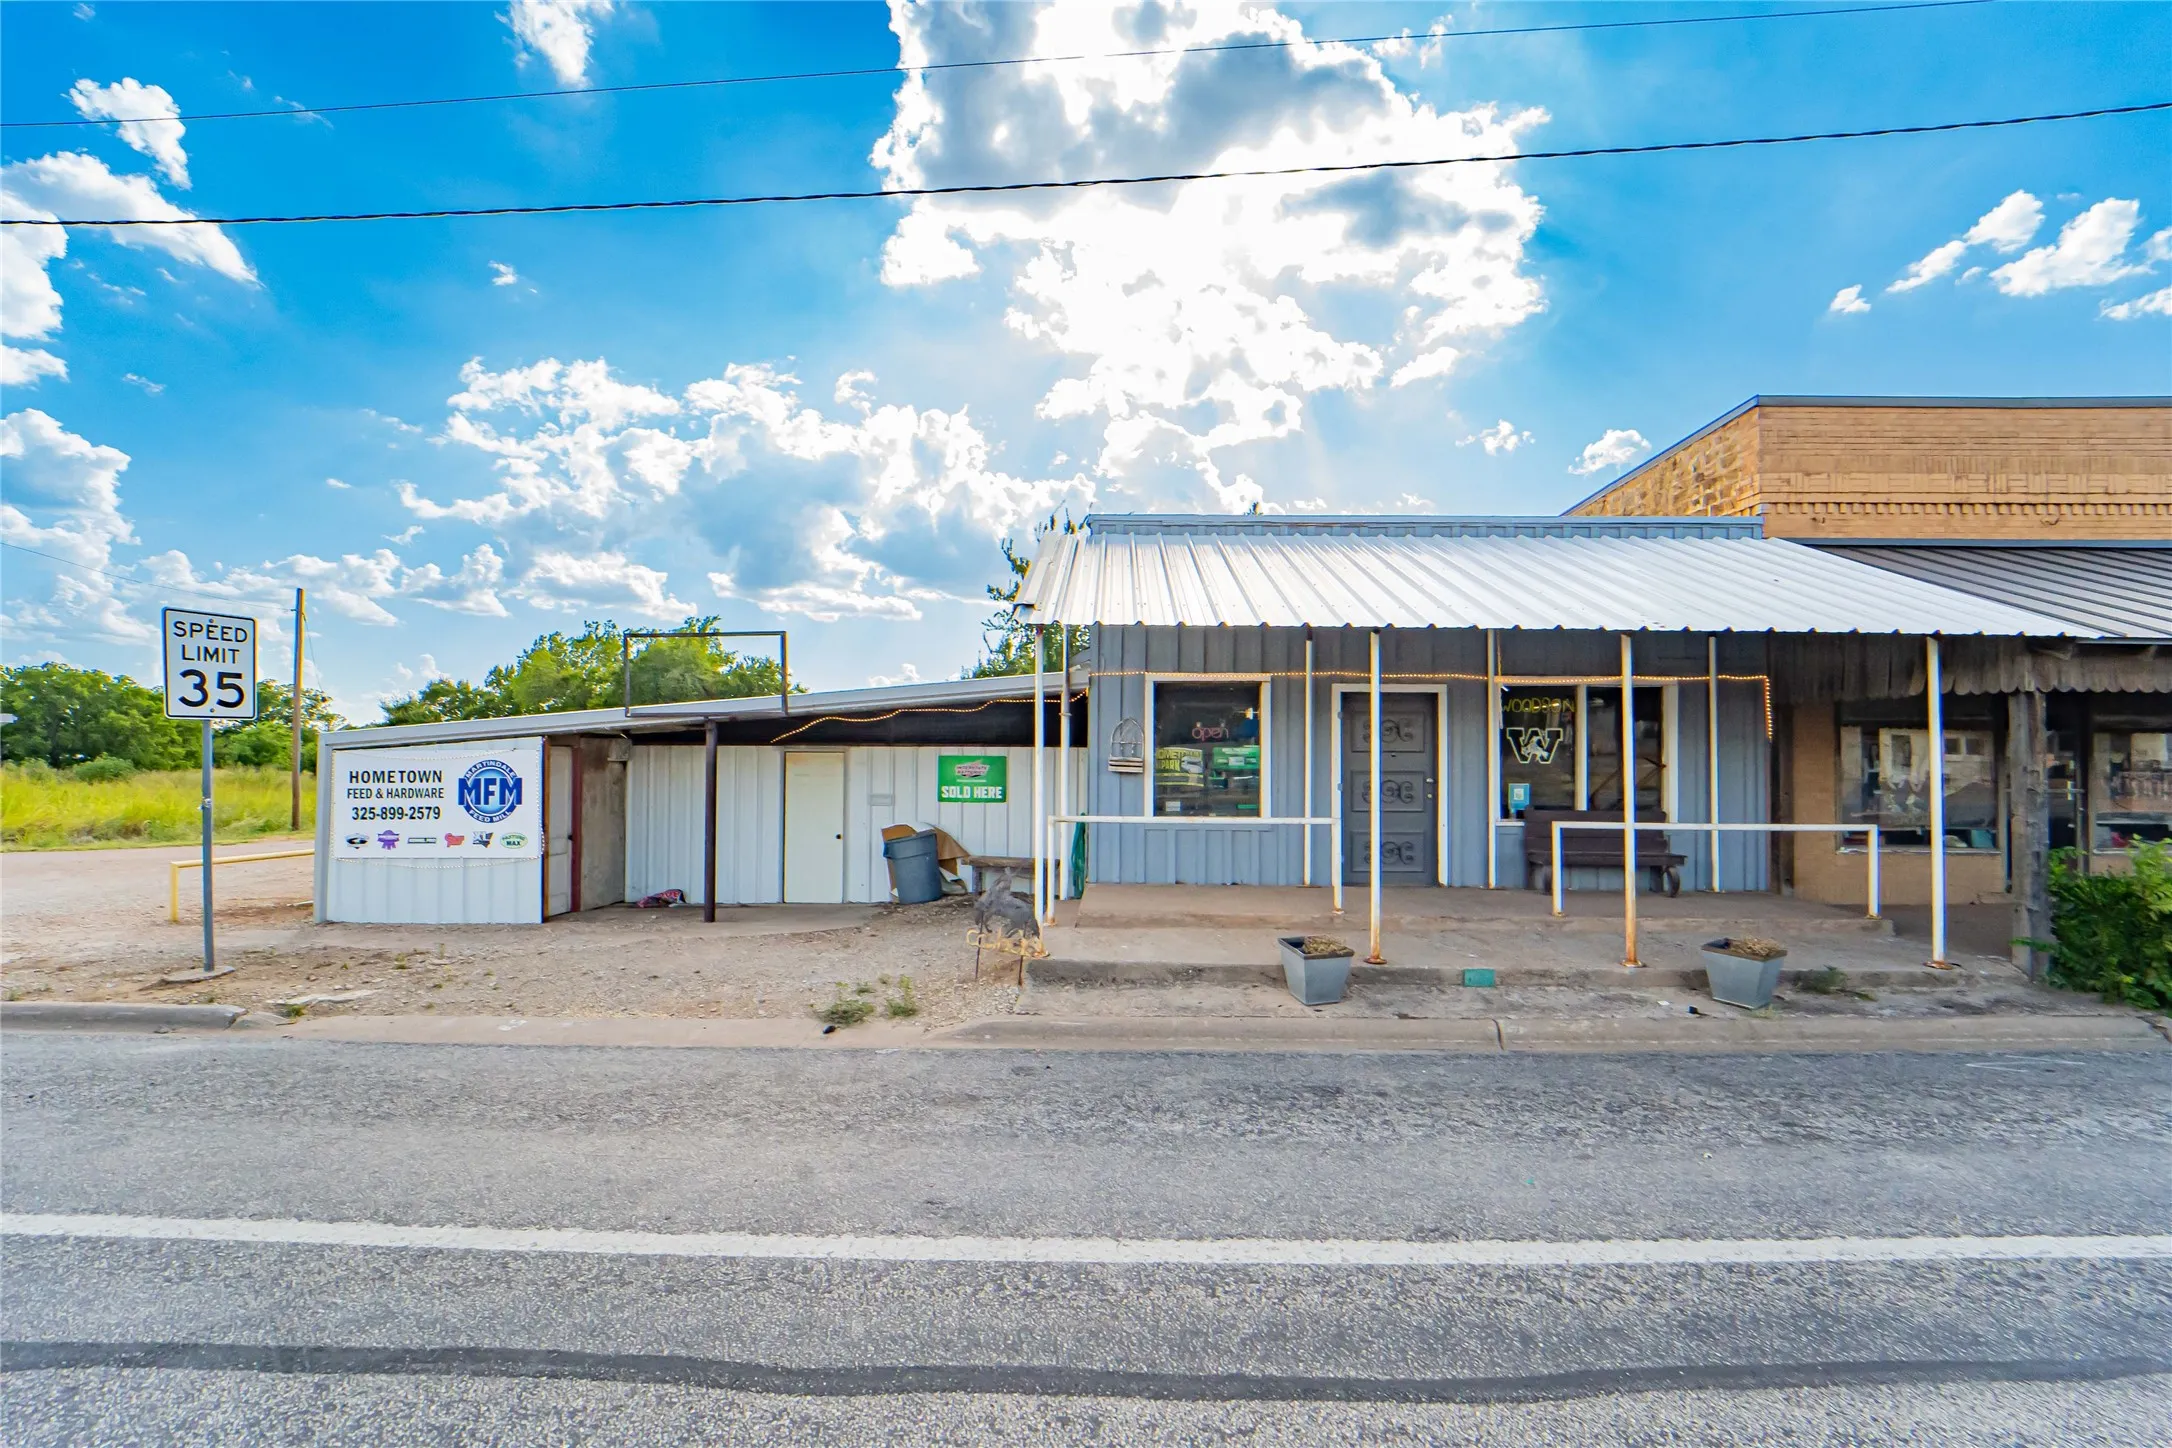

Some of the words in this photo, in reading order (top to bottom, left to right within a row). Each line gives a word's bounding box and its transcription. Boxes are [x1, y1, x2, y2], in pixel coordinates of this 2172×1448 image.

[173, 620, 248, 643] SPEED
[181, 644, 240, 664] LIMIT
[178, 669, 245, 708] 35
[1191, 726, 1229, 741] open
[349, 770, 443, 784] HOMETOWN
[465, 761, 517, 779] MARTINDALE
[347, 788, 373, 799] FEED
[375, 788, 384, 799] &
[386, 787, 445, 799] HARDWARE
[457, 777, 523, 806] MFM
[941, 785, 971, 798] SOLD
[973, 786, 1003, 799] HERE
[351, 806, 442, 820] 325-899-2579
[469, 809, 491, 822] FEED
[492, 811, 512, 822] MILL
